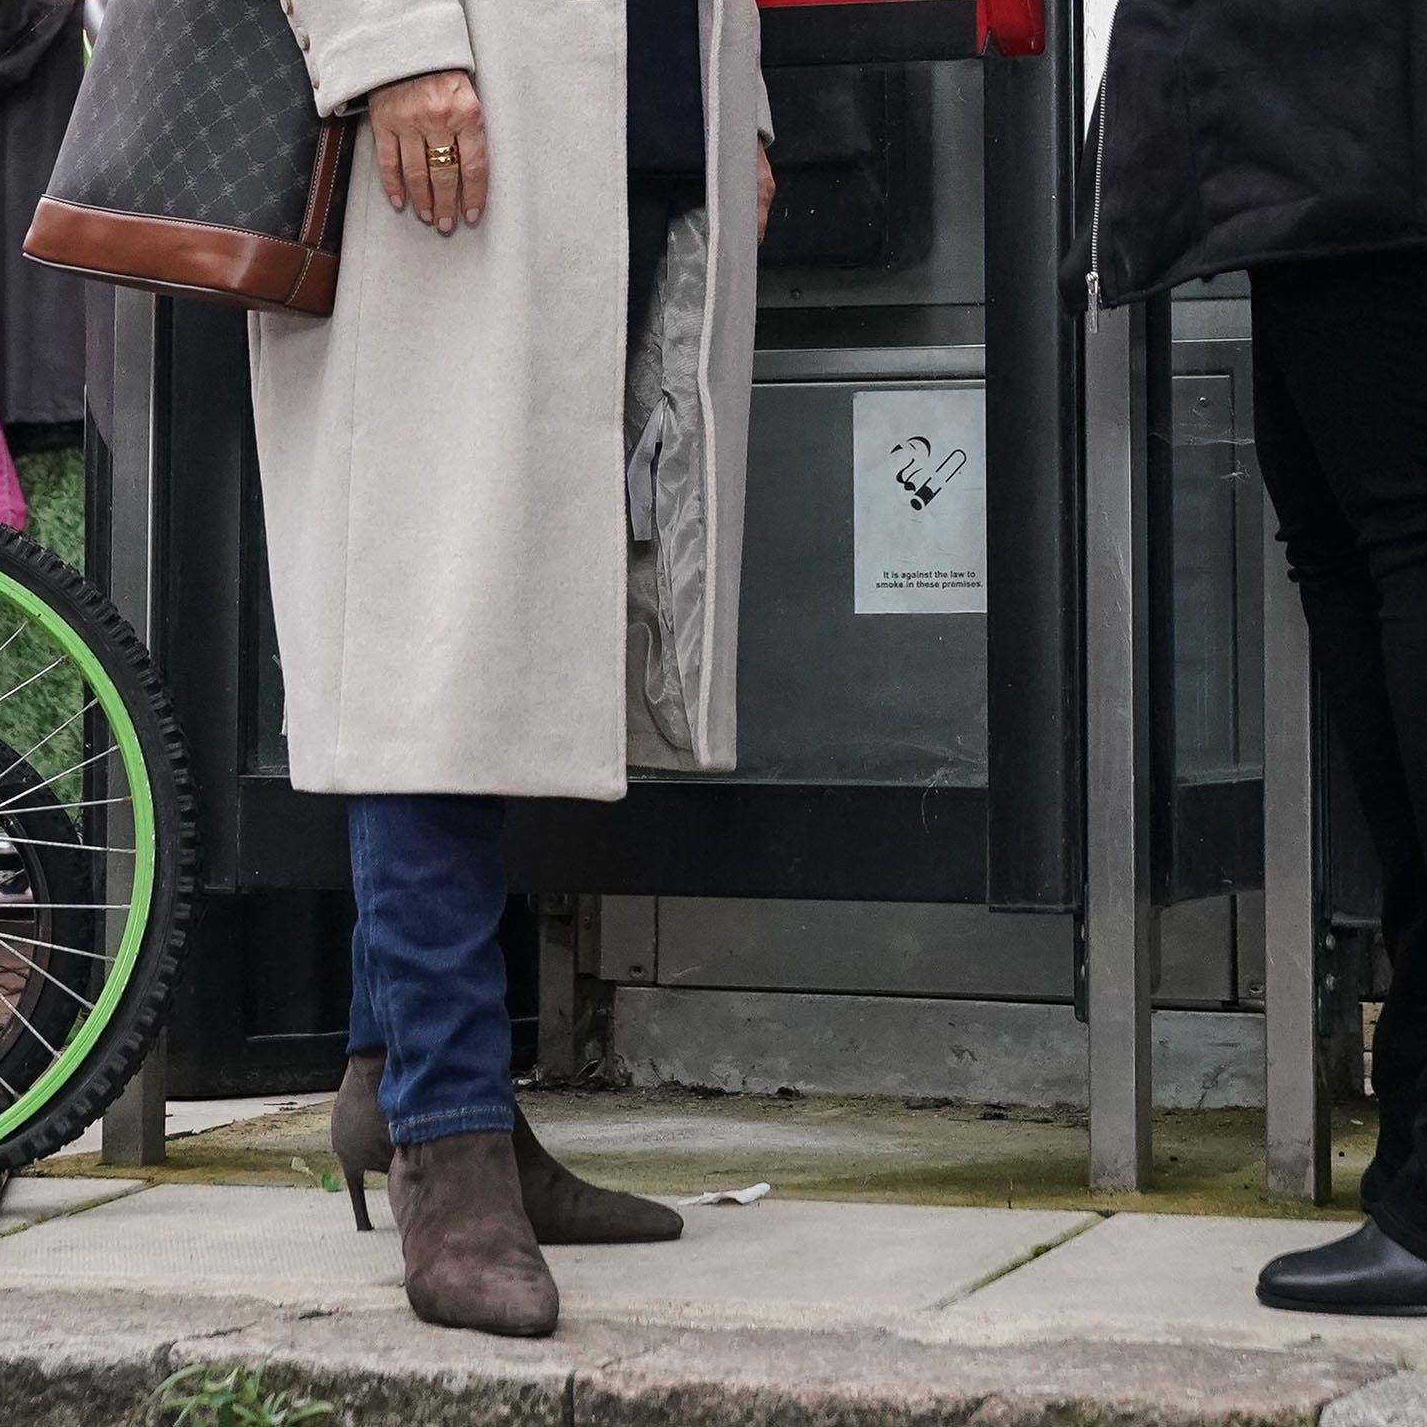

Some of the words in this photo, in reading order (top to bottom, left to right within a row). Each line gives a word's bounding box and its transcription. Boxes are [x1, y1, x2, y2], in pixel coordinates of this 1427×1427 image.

[883, 570, 889, 579] It
[891, 570, 898, 579] is
[901, 570, 933, 582] against
[934, 570, 949, 579] the
[950, 570, 965, 579] law
[966, 570, 976, 579] to
[876, 580, 904, 589] smoke
[905, 580, 915, 589] in
[916, 580, 940, 589] these
[941, 580, 983, 591] premises.
